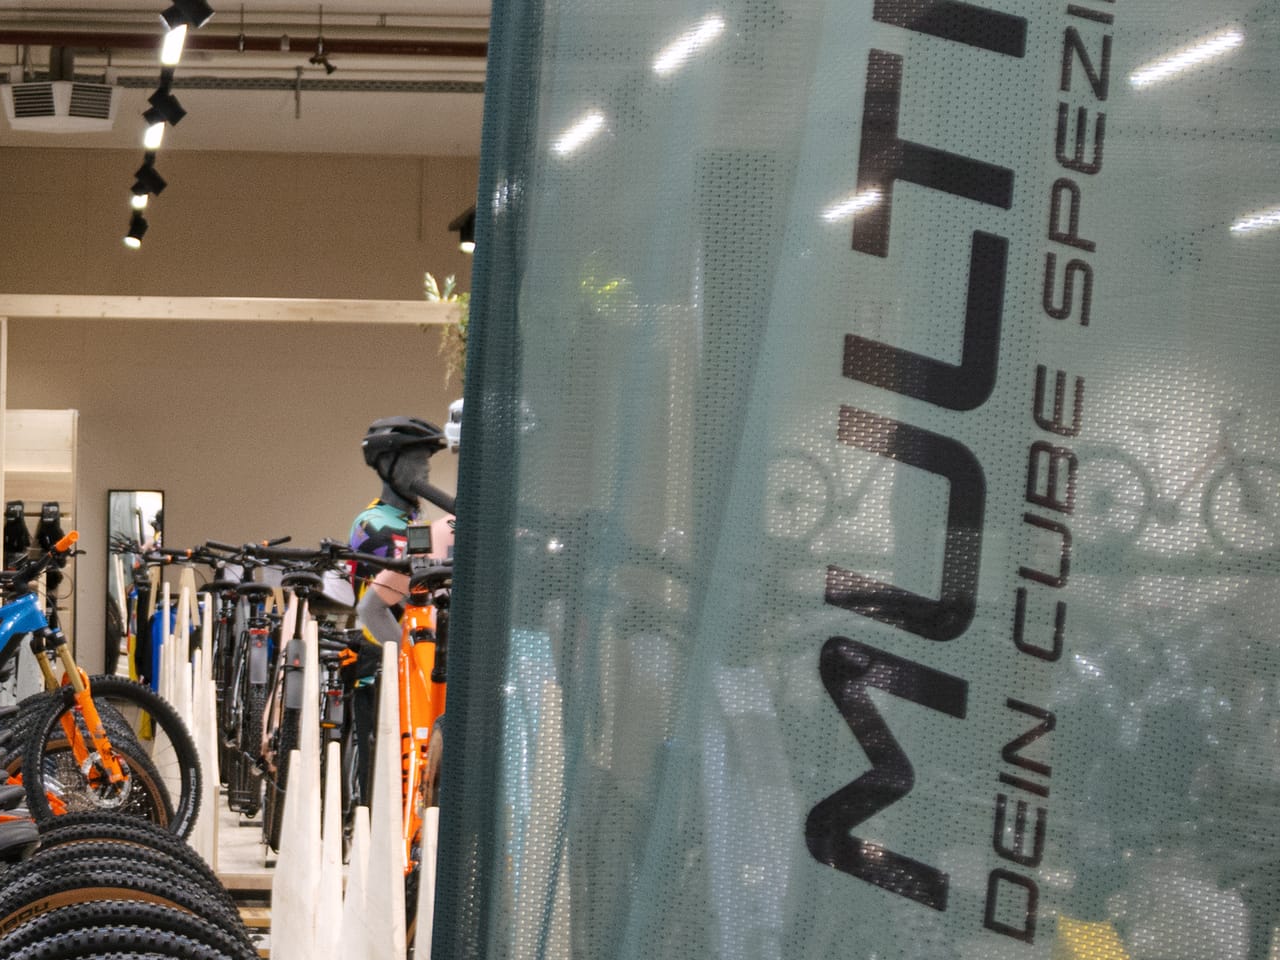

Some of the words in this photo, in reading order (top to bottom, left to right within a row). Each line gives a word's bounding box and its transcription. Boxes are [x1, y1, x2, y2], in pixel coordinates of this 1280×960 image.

[1042, 0, 1117, 327] SPEZI
[1013, 364, 1085, 662] CUBE
[983, 697, 1057, 945] DEIN
